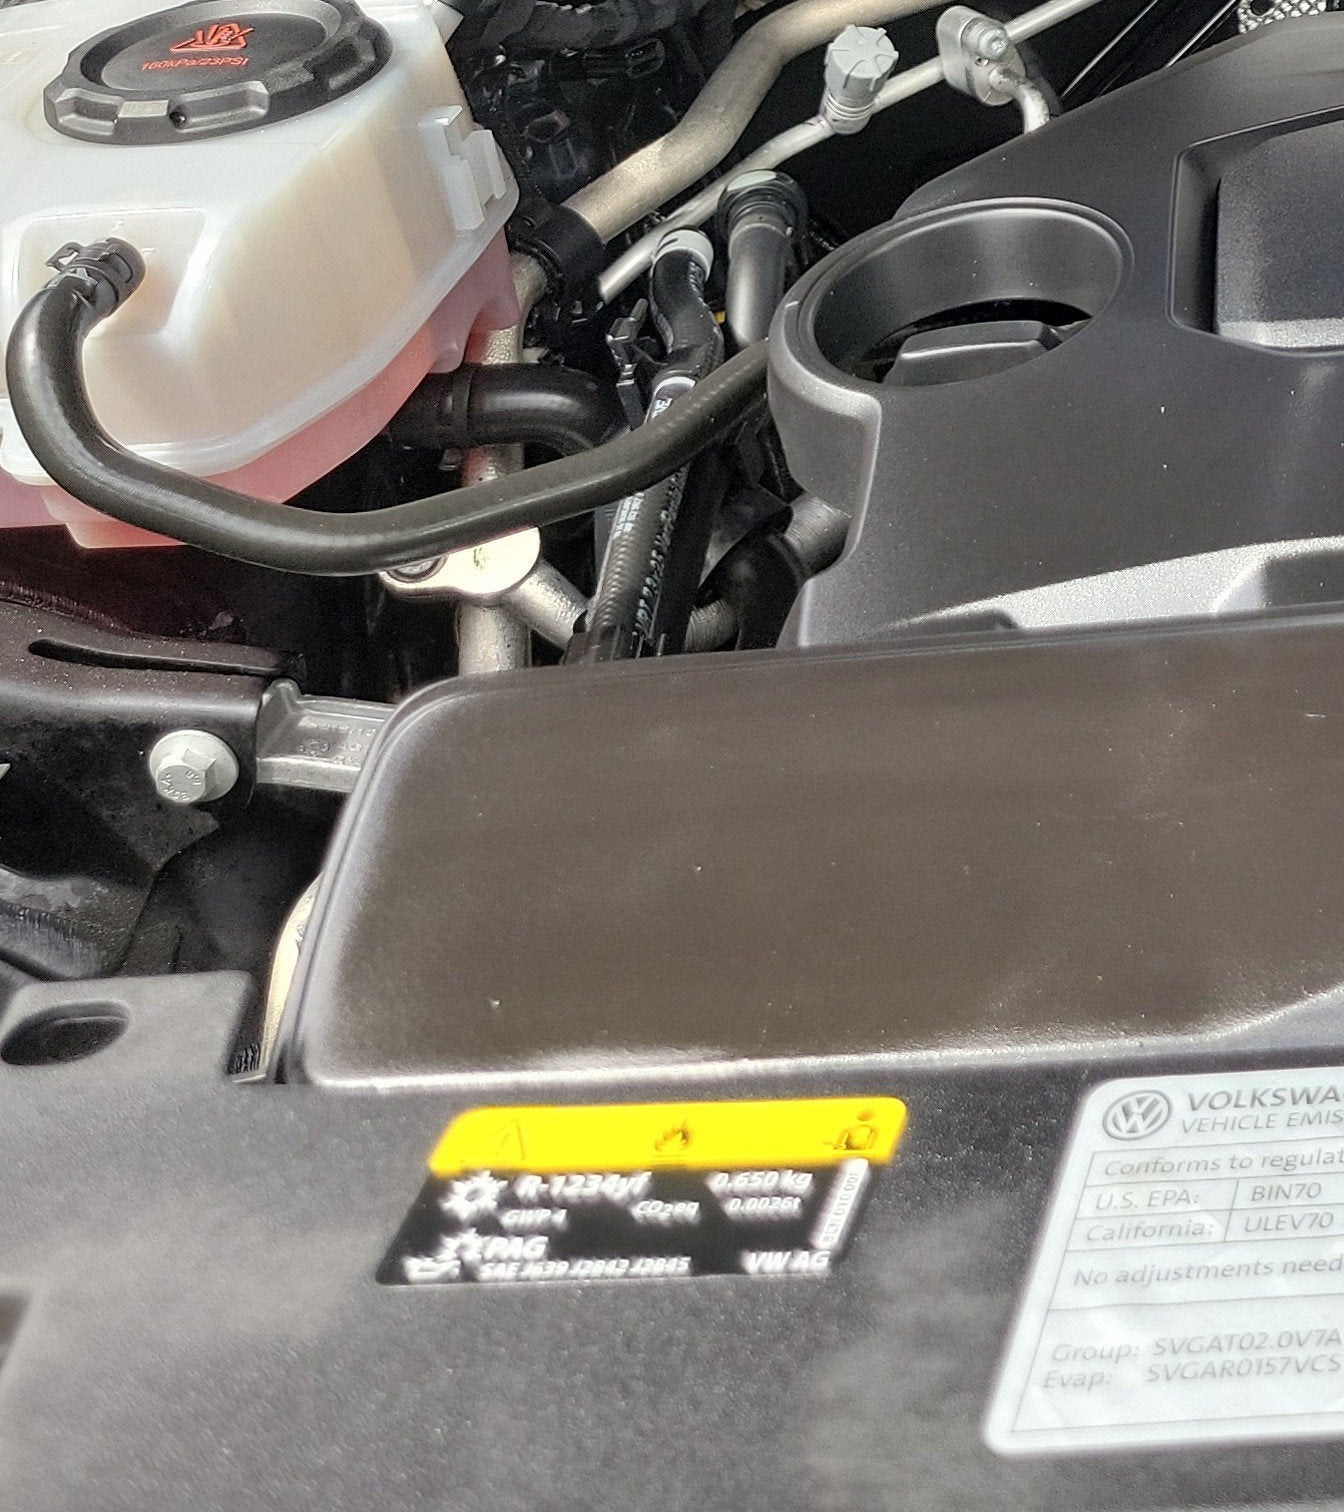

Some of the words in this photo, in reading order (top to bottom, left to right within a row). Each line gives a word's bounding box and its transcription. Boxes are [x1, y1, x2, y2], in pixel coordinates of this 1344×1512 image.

[1181, 1112, 1280, 1135] VEHICLE
[1104, 1156, 1220, 1177] Conforms
[1227, 1152, 1253, 1171] to
[515, 1171, 652, 1202] R-1234yf
[711, 1171, 780, 1191] 0.650
[781, 1170, 813, 1192] kg
[1095, 1192, 1139, 1211] U.S.
[1147, 1189, 1200, 1208] EPA:
[1250, 1181, 1323, 1202] BIN70
[502, 1208, 551, 1228] GWP
[729, 1196, 801, 1214] 0.0026t
[1085, 1218, 1215, 1243] California:
[1243, 1211, 1335, 1233] ULEV70
[484, 1236, 548, 1260] PAG
[479, 1261, 520, 1280] SAE
[745, 1250, 791, 1273] VW
[791, 1250, 831, 1272] AG
[1073, 1268, 1109, 1288] No
[1114, 1259, 1273, 1289] adjustments
[1051, 1342, 1139, 1365] Group:
[1151, 1328, 1343, 1356] SVGAT02.0V7A
[1043, 1368, 1113, 1390] Evap:
[1147, 1353, 1342, 1383] SVGAR0157VCS
